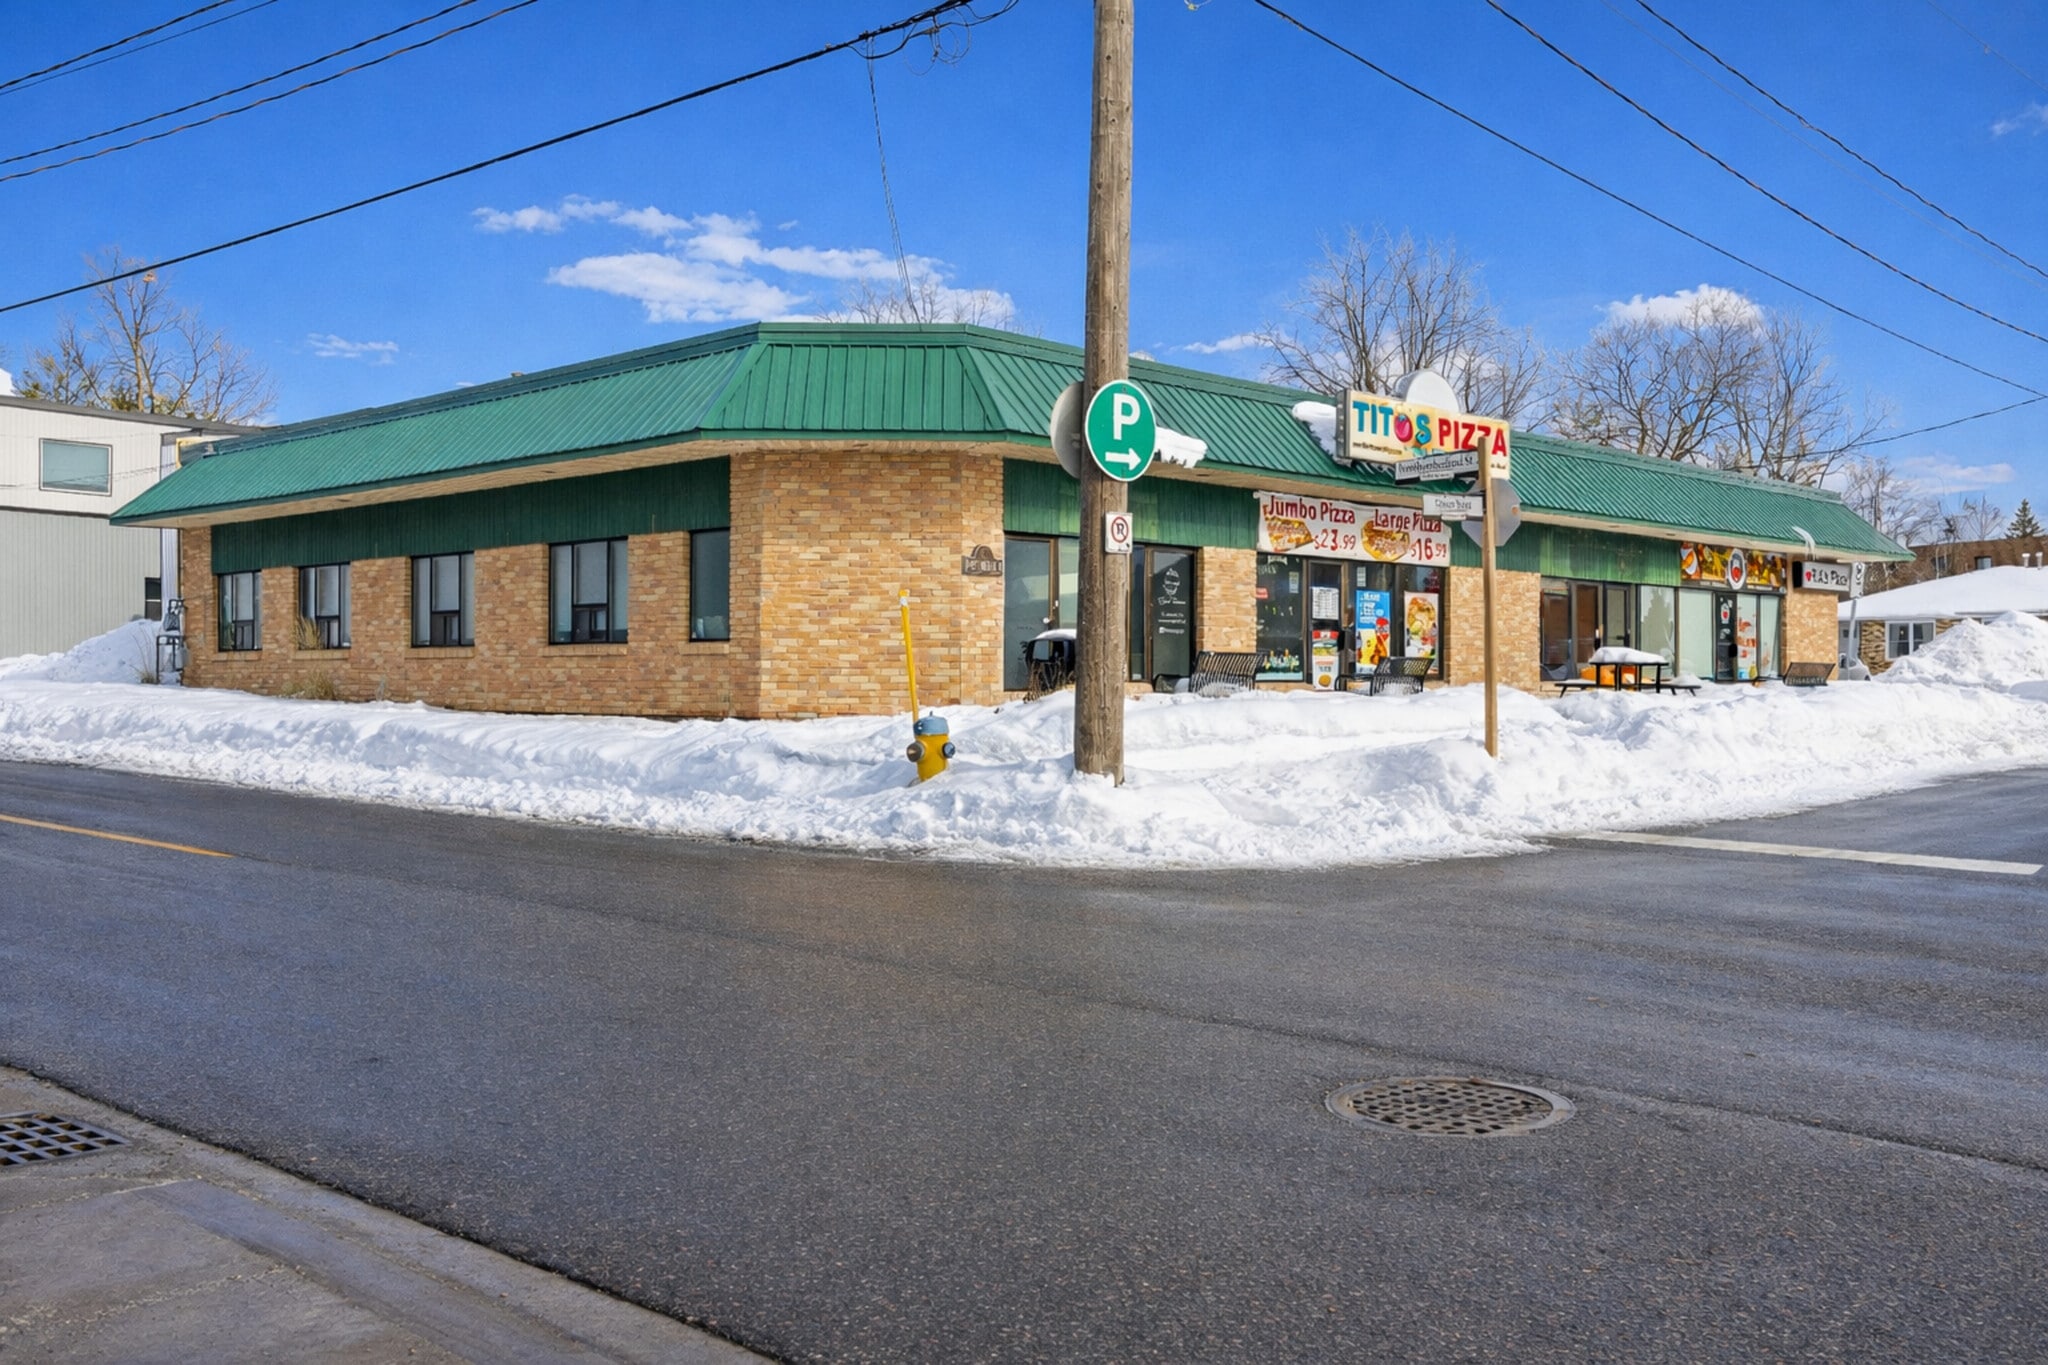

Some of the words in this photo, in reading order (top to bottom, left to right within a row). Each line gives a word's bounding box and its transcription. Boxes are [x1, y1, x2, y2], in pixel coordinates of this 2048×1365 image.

[1113, 393, 1141, 440] P
[1269, 495, 1317, 520] Jumbo
[1320, 502, 1355, 524] Pizza
[1375, 509, 1410, 533] Large
